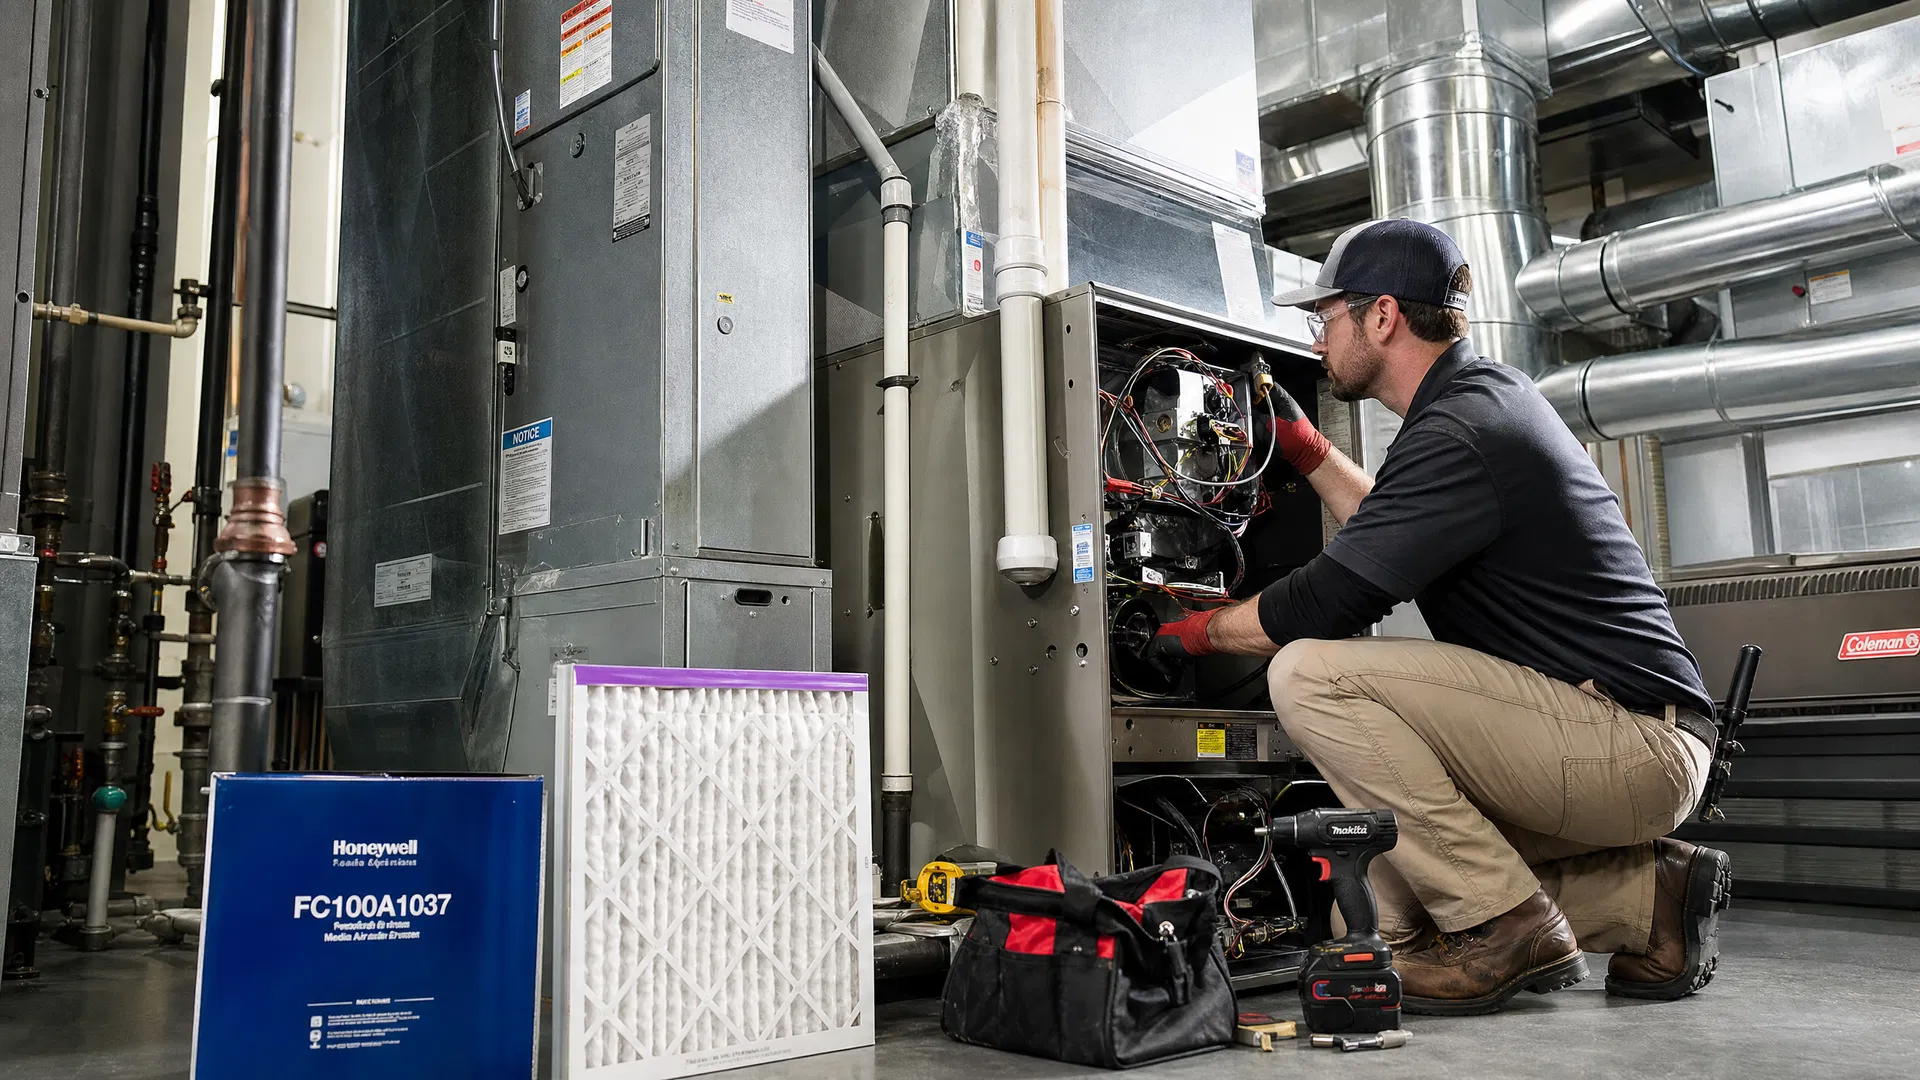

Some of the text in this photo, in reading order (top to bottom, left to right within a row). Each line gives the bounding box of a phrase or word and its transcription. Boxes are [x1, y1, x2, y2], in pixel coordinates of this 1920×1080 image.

[512, 426, 540, 444] NOTICE
[1846, 636, 1903, 652] Coleman
[333, 839, 418, 858] Honeywell
[293, 893, 452, 919] FC100A1037
